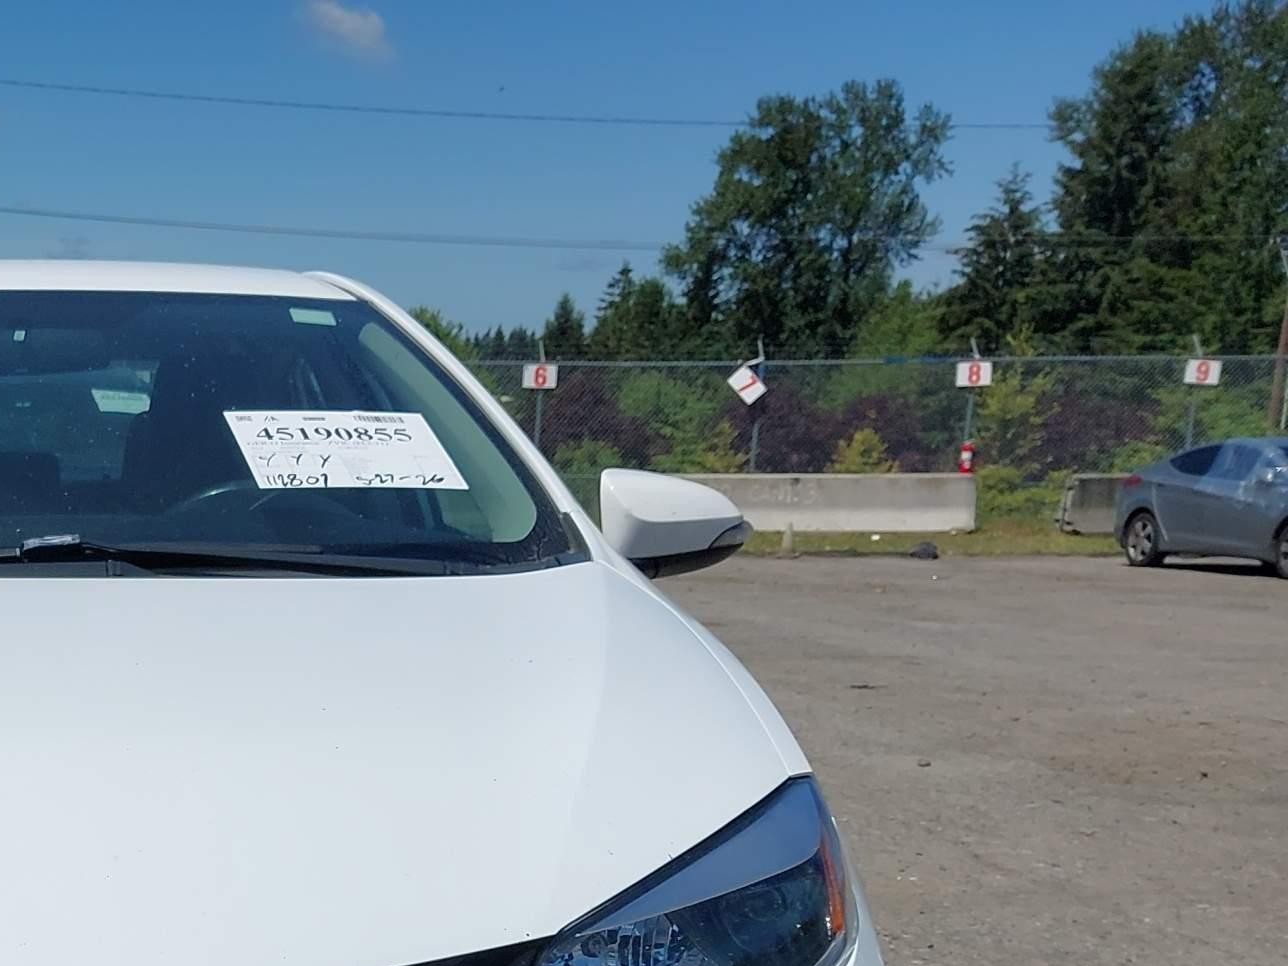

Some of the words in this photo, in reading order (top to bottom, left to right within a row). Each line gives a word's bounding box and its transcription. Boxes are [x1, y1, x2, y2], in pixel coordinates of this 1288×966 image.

[534, 366, 548, 387] 6
[968, 363, 981, 384] 8
[1195, 361, 1211, 382] 9
[255, 426, 413, 443] 45190855
